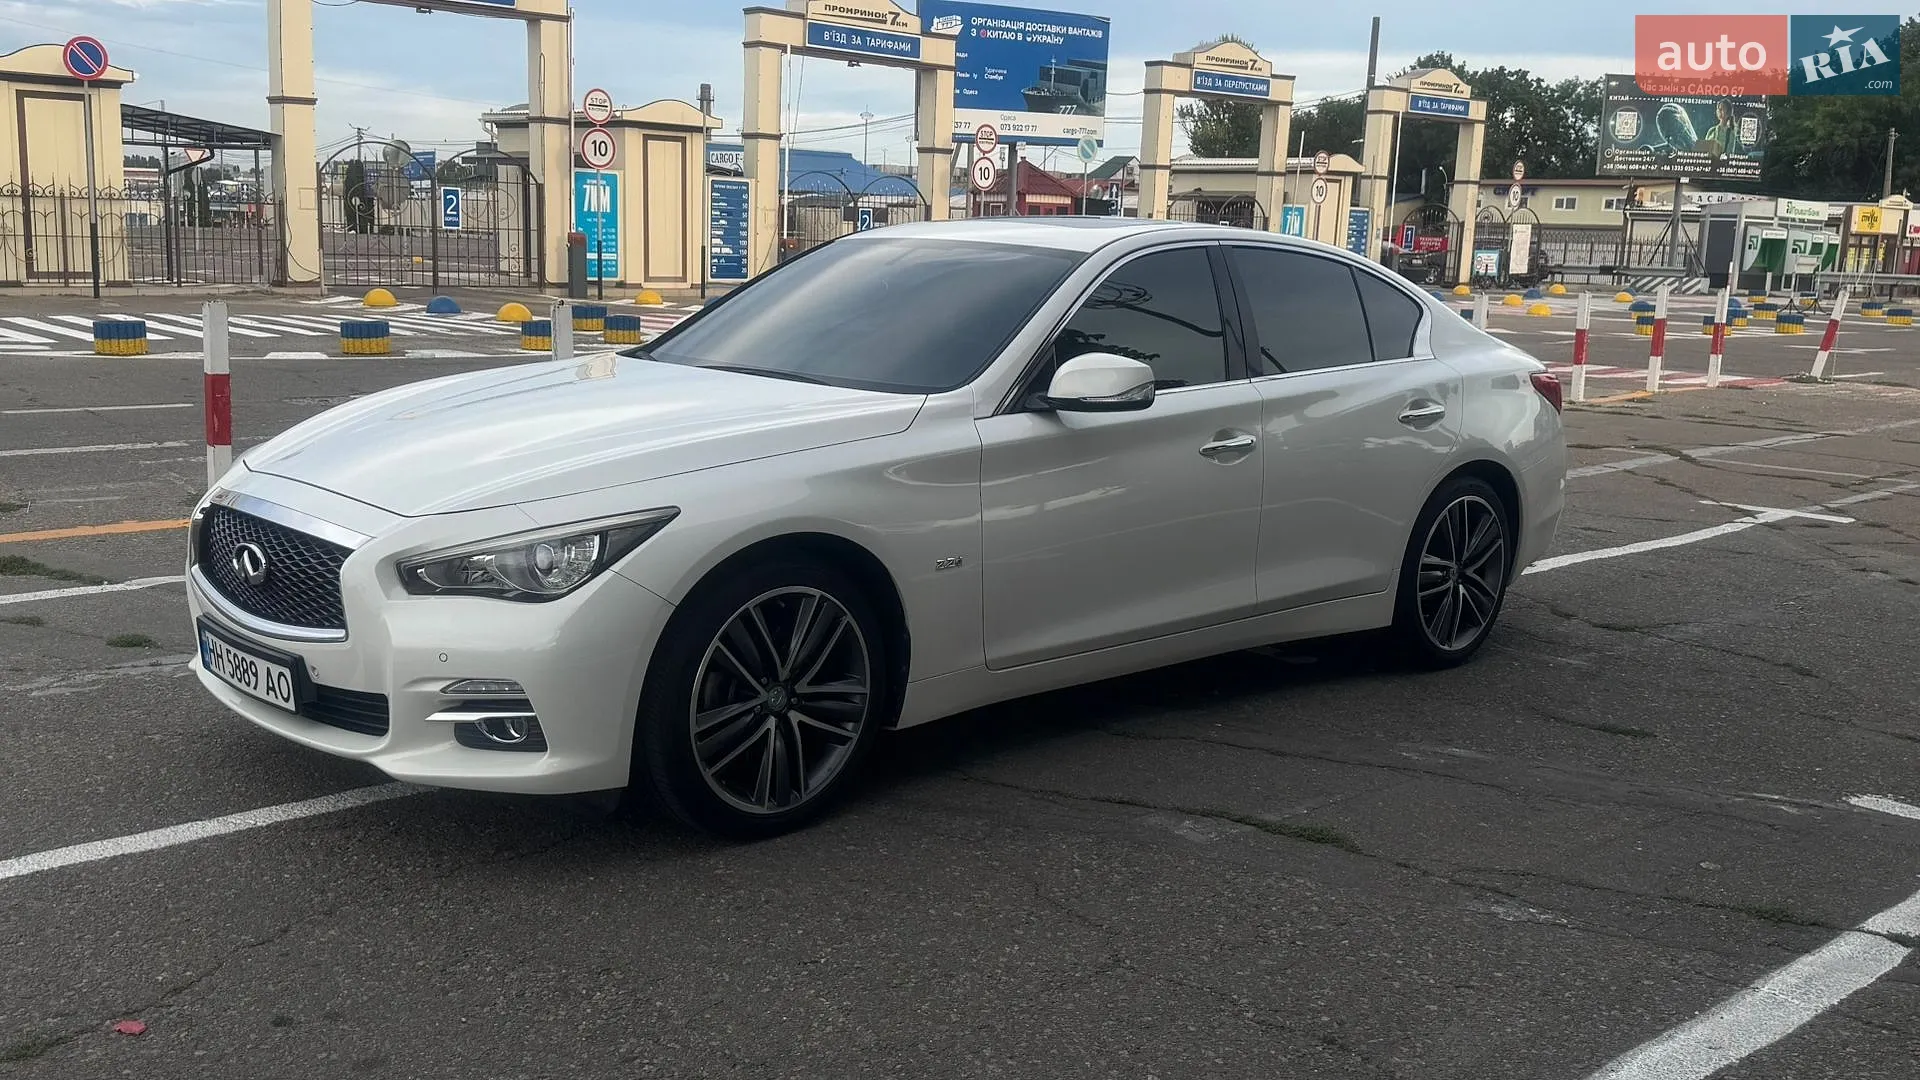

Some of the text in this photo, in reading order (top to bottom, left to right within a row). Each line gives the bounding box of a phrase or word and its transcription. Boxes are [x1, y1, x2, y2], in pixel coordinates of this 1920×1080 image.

[824, 4, 888, 20] ПРОМРИНОК
[971, 17, 1103, 38] ОРГАНІЗАЦІЯ ДОСТАВКИ ВАНТАЖІВ
[824, 30, 911, 52] В'ЇЗД ЗА ТАРИФАМИ
[987, 30, 1016, 40] КИТАЮ
[1032, 34, 1064, 45] УКРАЇНУ
[1206, 55, 1248, 66] ПРОМРИНОК
[1224, 80, 1268, 92] ПЕРЕПУСТКАМИ
[1640, 82, 1657, 92] Час
[1659, 83, 1679, 93] змін
[1688, 84, 1729, 97] CARGO
[1730, 86, 1744, 98] 67
[1060, 105, 1077, 114] 777
[591, 140, 608, 157] 10
[710, 152, 733, 164] CARGO
[978, 166, 990, 181] 10
[1316, 185, 1324, 197] 10
[446, 194, 457, 215] 2
[862, 215, 869, 230] 2
[1406, 230, 1412, 241] 1
[226, 648, 259, 690] 5889
[266, 666, 291, 703] AO
